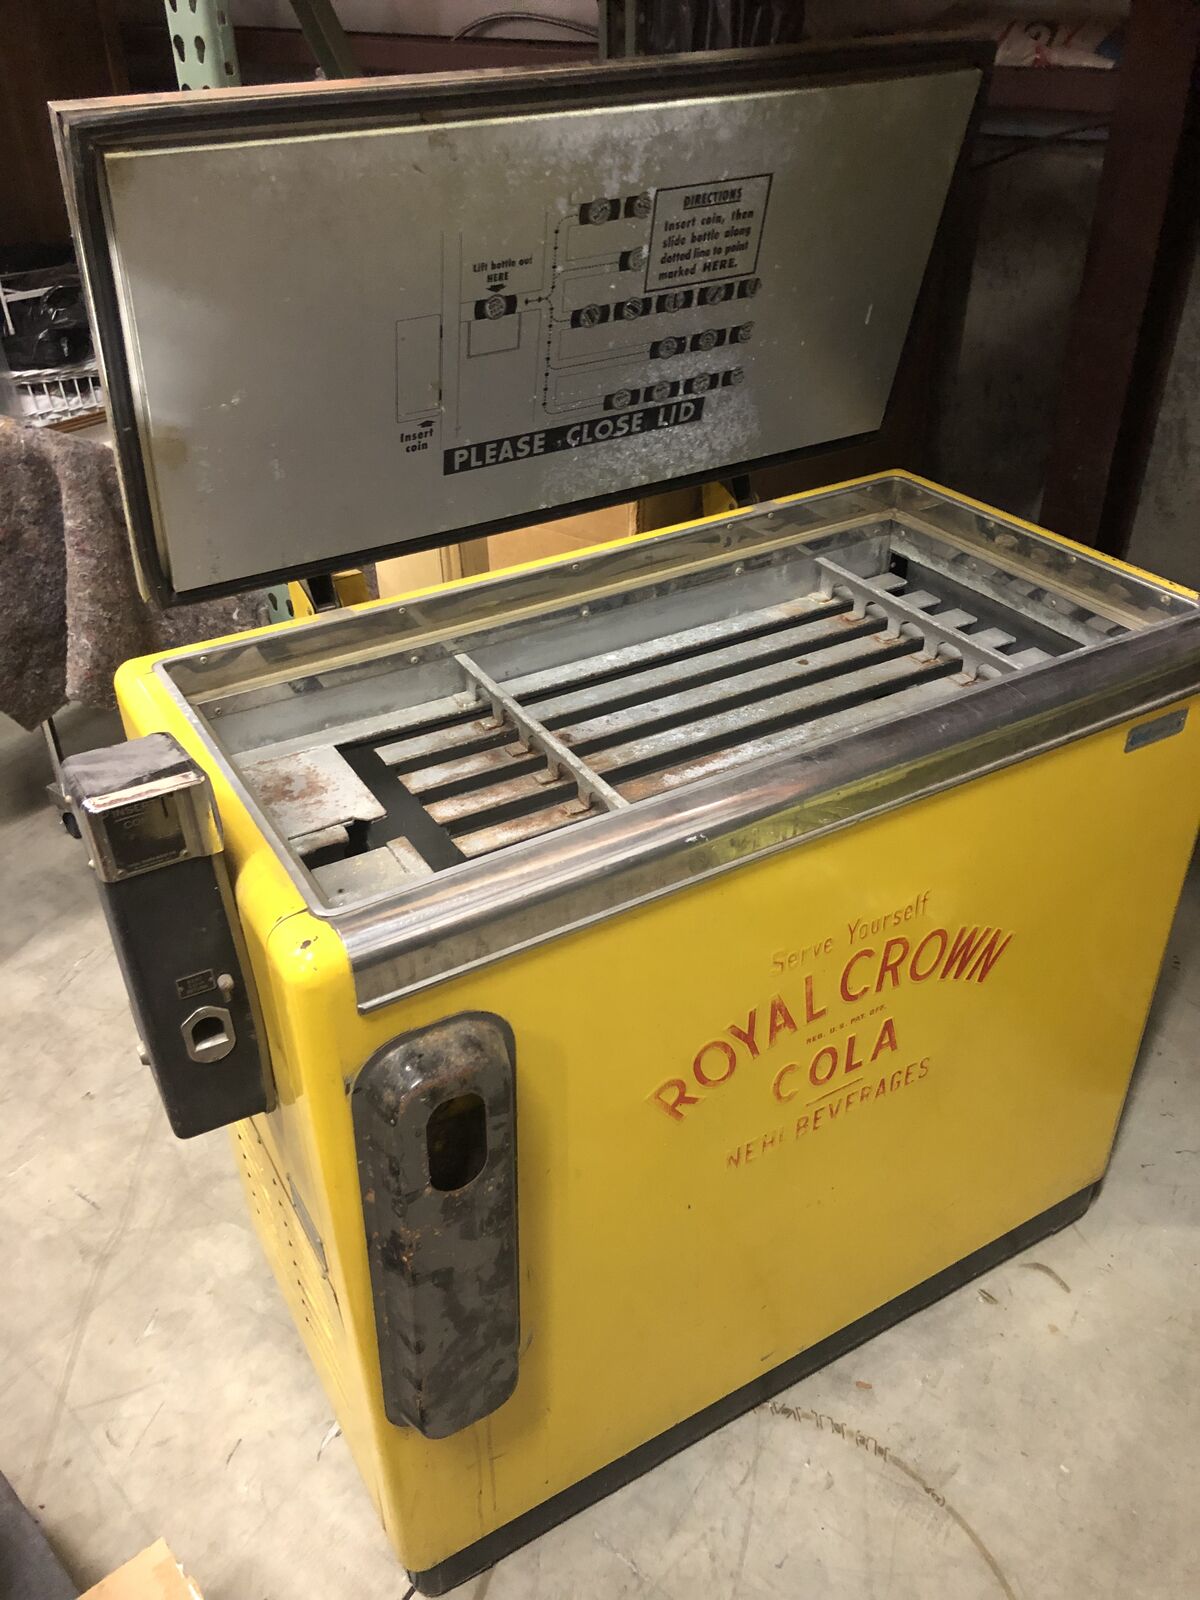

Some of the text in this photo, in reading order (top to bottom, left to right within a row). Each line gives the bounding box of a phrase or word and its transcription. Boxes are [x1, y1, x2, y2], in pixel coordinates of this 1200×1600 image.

[683, 187, 742, 207] DIRECTIONS
[664, 208, 754, 232] Insert coin, then
[662, 225, 752, 249] slide bottle along
[473, 262, 488, 272] Lift
[491, 258, 516, 270] bottle
[660, 241, 749, 265] dotted line to point
[487, 272, 509, 283] HERE
[658, 258, 738, 280] marked HERE.
[399, 428, 434, 444] Insert
[405, 441, 429, 453] coin
[452, 402, 695, 471] PLEASE CLOSE LID
[769, 889, 932, 975] Serve Yourself
[652, 926, 1013, 1121] ROYAL CROWN
[772, 1017, 899, 1104] COLA
[795, 1057, 931, 1141] BEVERAGES
